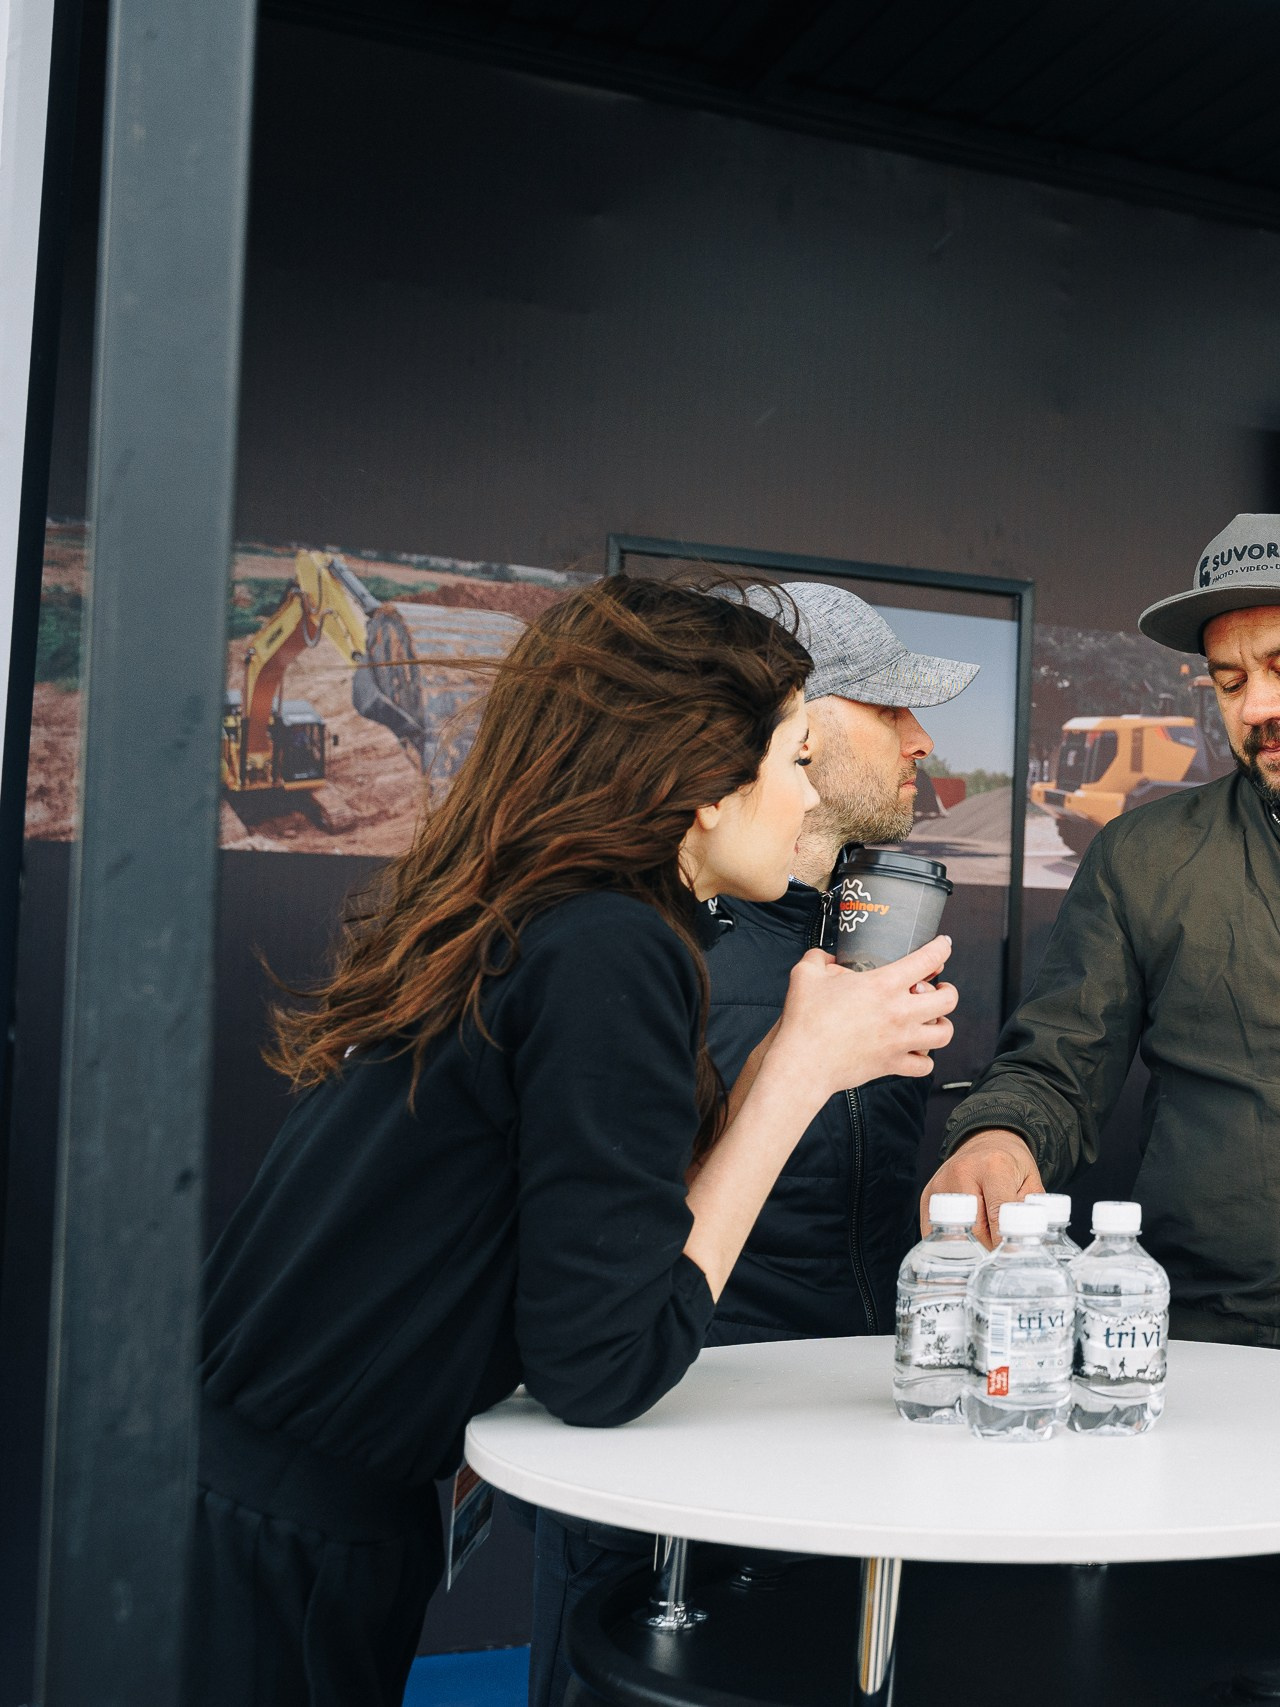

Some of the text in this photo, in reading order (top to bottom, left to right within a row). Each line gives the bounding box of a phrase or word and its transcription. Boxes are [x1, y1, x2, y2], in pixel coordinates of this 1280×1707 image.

[1211, 569, 1234, 585] PHOTO
[1240, 564, 1269, 573] VIDEO
[840, 900, 890, 916] achinery
